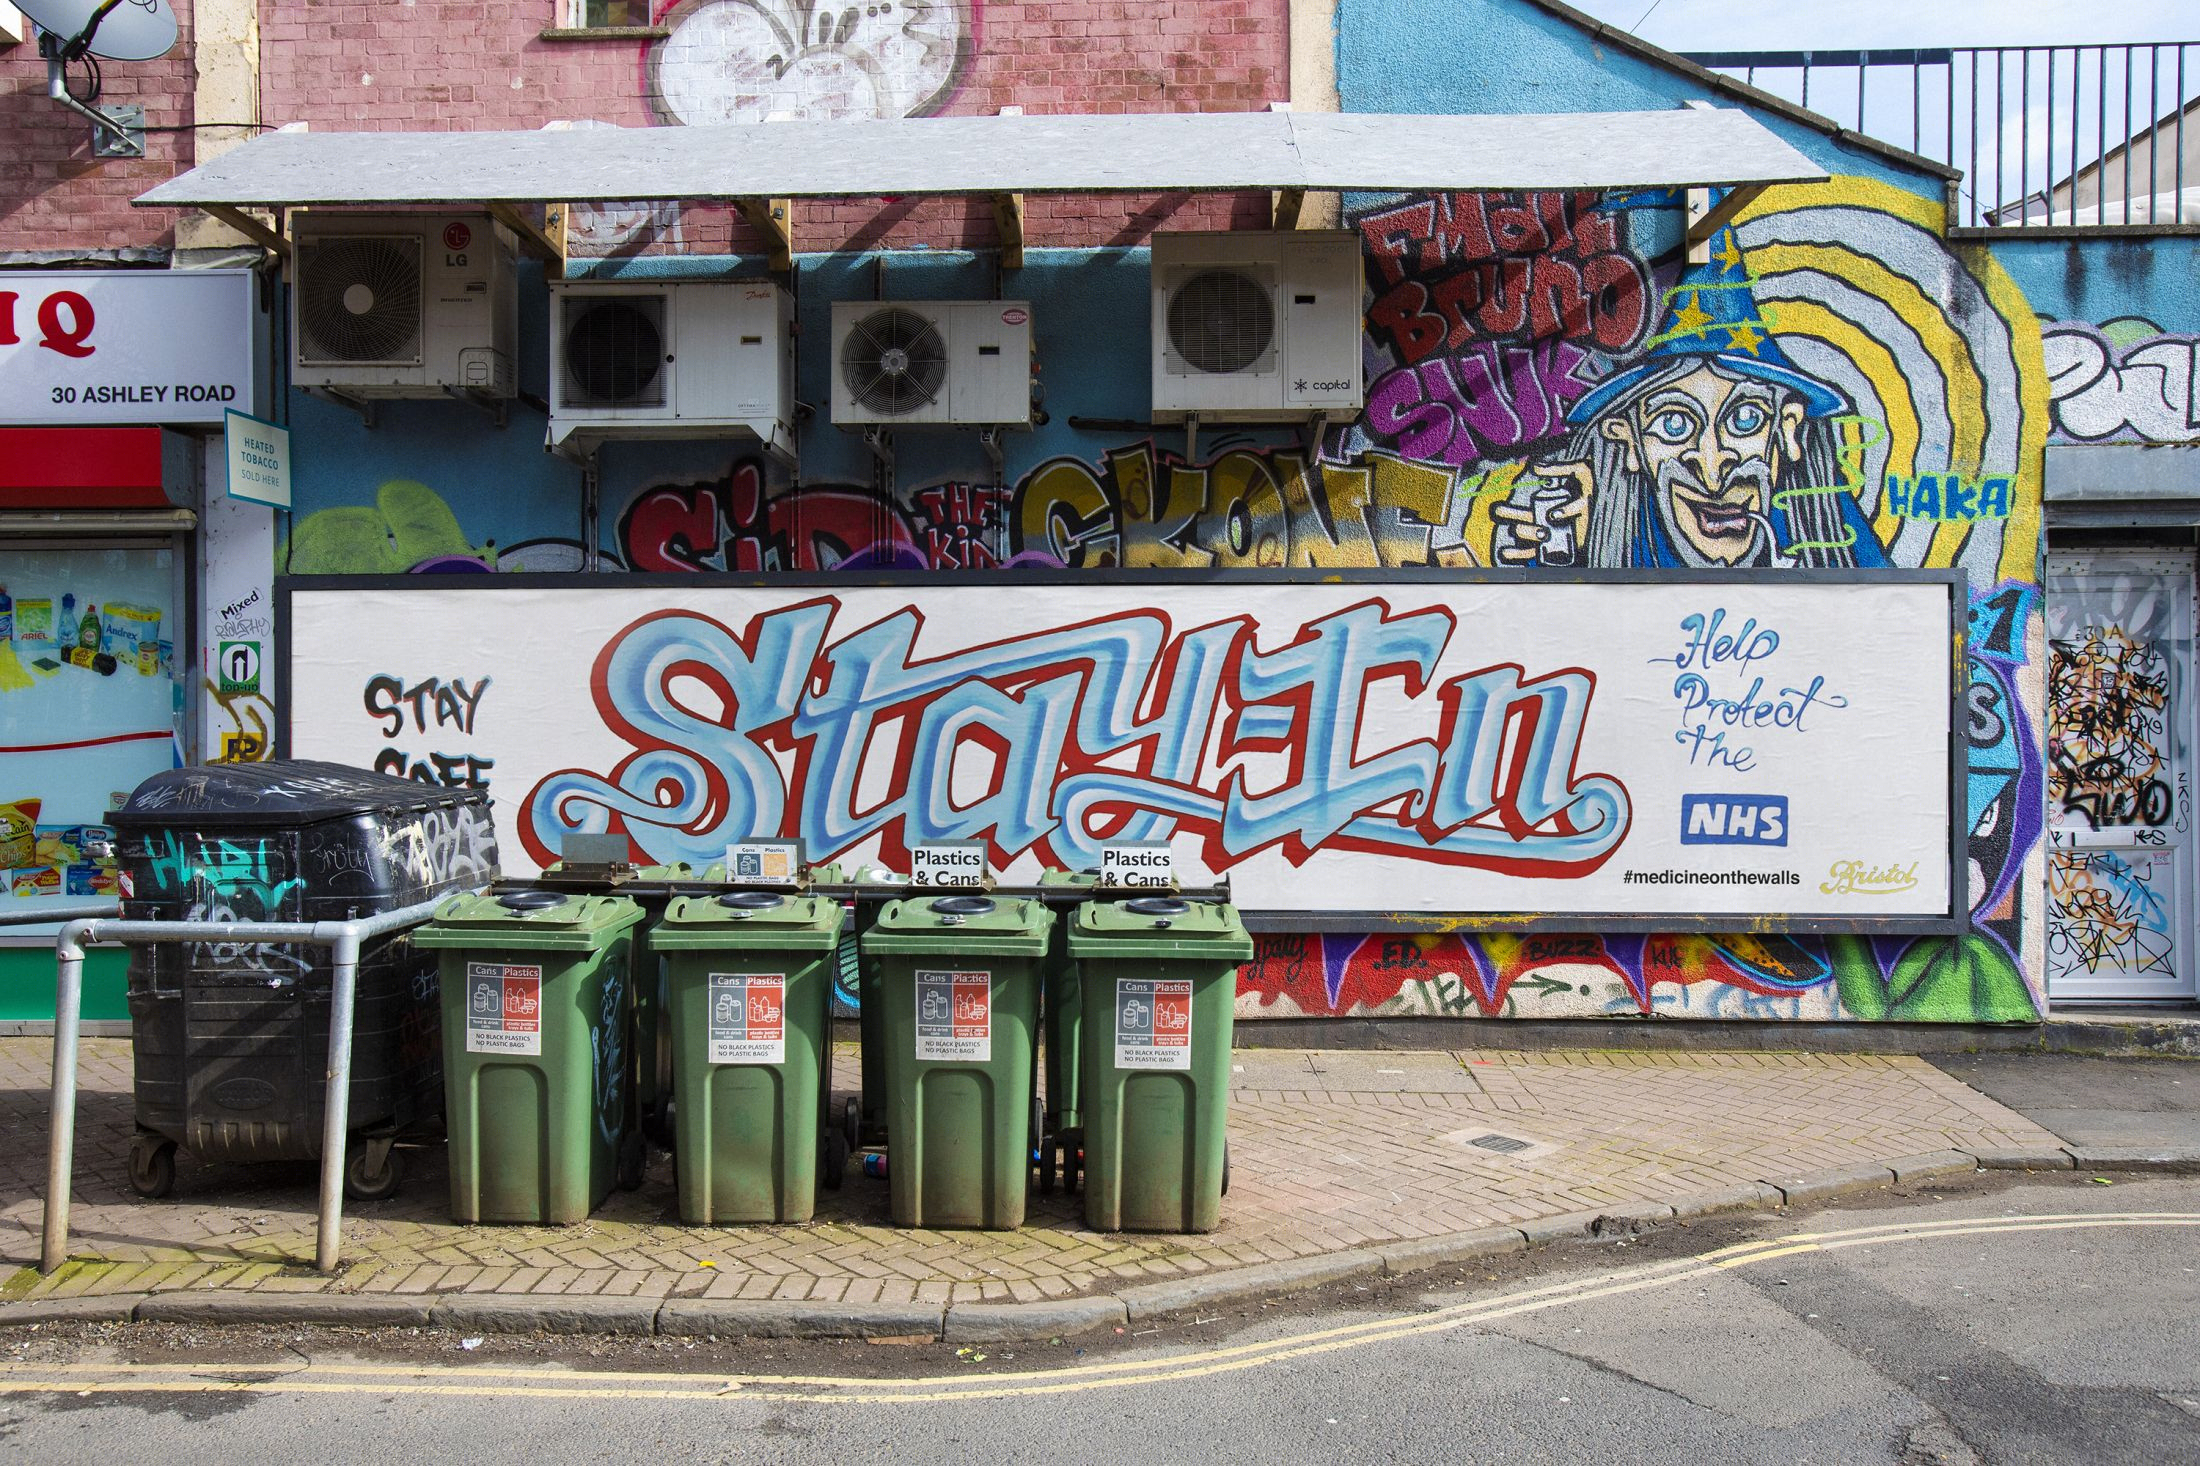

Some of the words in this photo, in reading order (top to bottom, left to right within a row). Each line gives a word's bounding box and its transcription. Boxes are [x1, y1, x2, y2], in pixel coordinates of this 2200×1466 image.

[446, 254, 467, 267] LG
[1313, 379, 1351, 393] capital
[52, 387, 77, 404] 30
[82, 386, 169, 403] ASHLEY
[175, 385, 236, 402] ROAD
[244, 436, 275, 455] HEATED
[241, 451, 279, 471] TOBACCO
[241, 469, 261, 483] SOLD
[262, 471, 280, 487] HERE
[221, 590, 261, 620] Mixed
[21, 632, 48, 641] ARIEL
[105, 623, 138, 641] Andrex
[1648, 608, 1780, 678] Help
[221, 680, 259, 693] top-up
[363, 672, 493, 738] STAY
[1673, 673, 1849, 732] Protect
[1675, 724, 1757, 773] The
[1686, 802, 1785, 841] NHS
[914, 850, 981, 866] Plastics
[1103, 850, 1170, 867] Plastics
[916, 870, 929, 886] &
[935, 870, 980, 886] Cans
[1105, 872, 1118, 887] &
[1125, 872, 1170, 887] Cans
[1623, 869, 1800, 886] #medicineonthewalls
[1818, 860, 1920, 895] Bristol
[476, 966, 497, 975] Cans
[504, 968, 538, 977] Plastics
[924, 974, 946, 982] Cans
[717, 977, 740, 985] Cans
[747, 976, 782, 985] Plastics
[1126, 983, 1148, 991] Cans
[1156, 983, 1190, 992] Plastics
